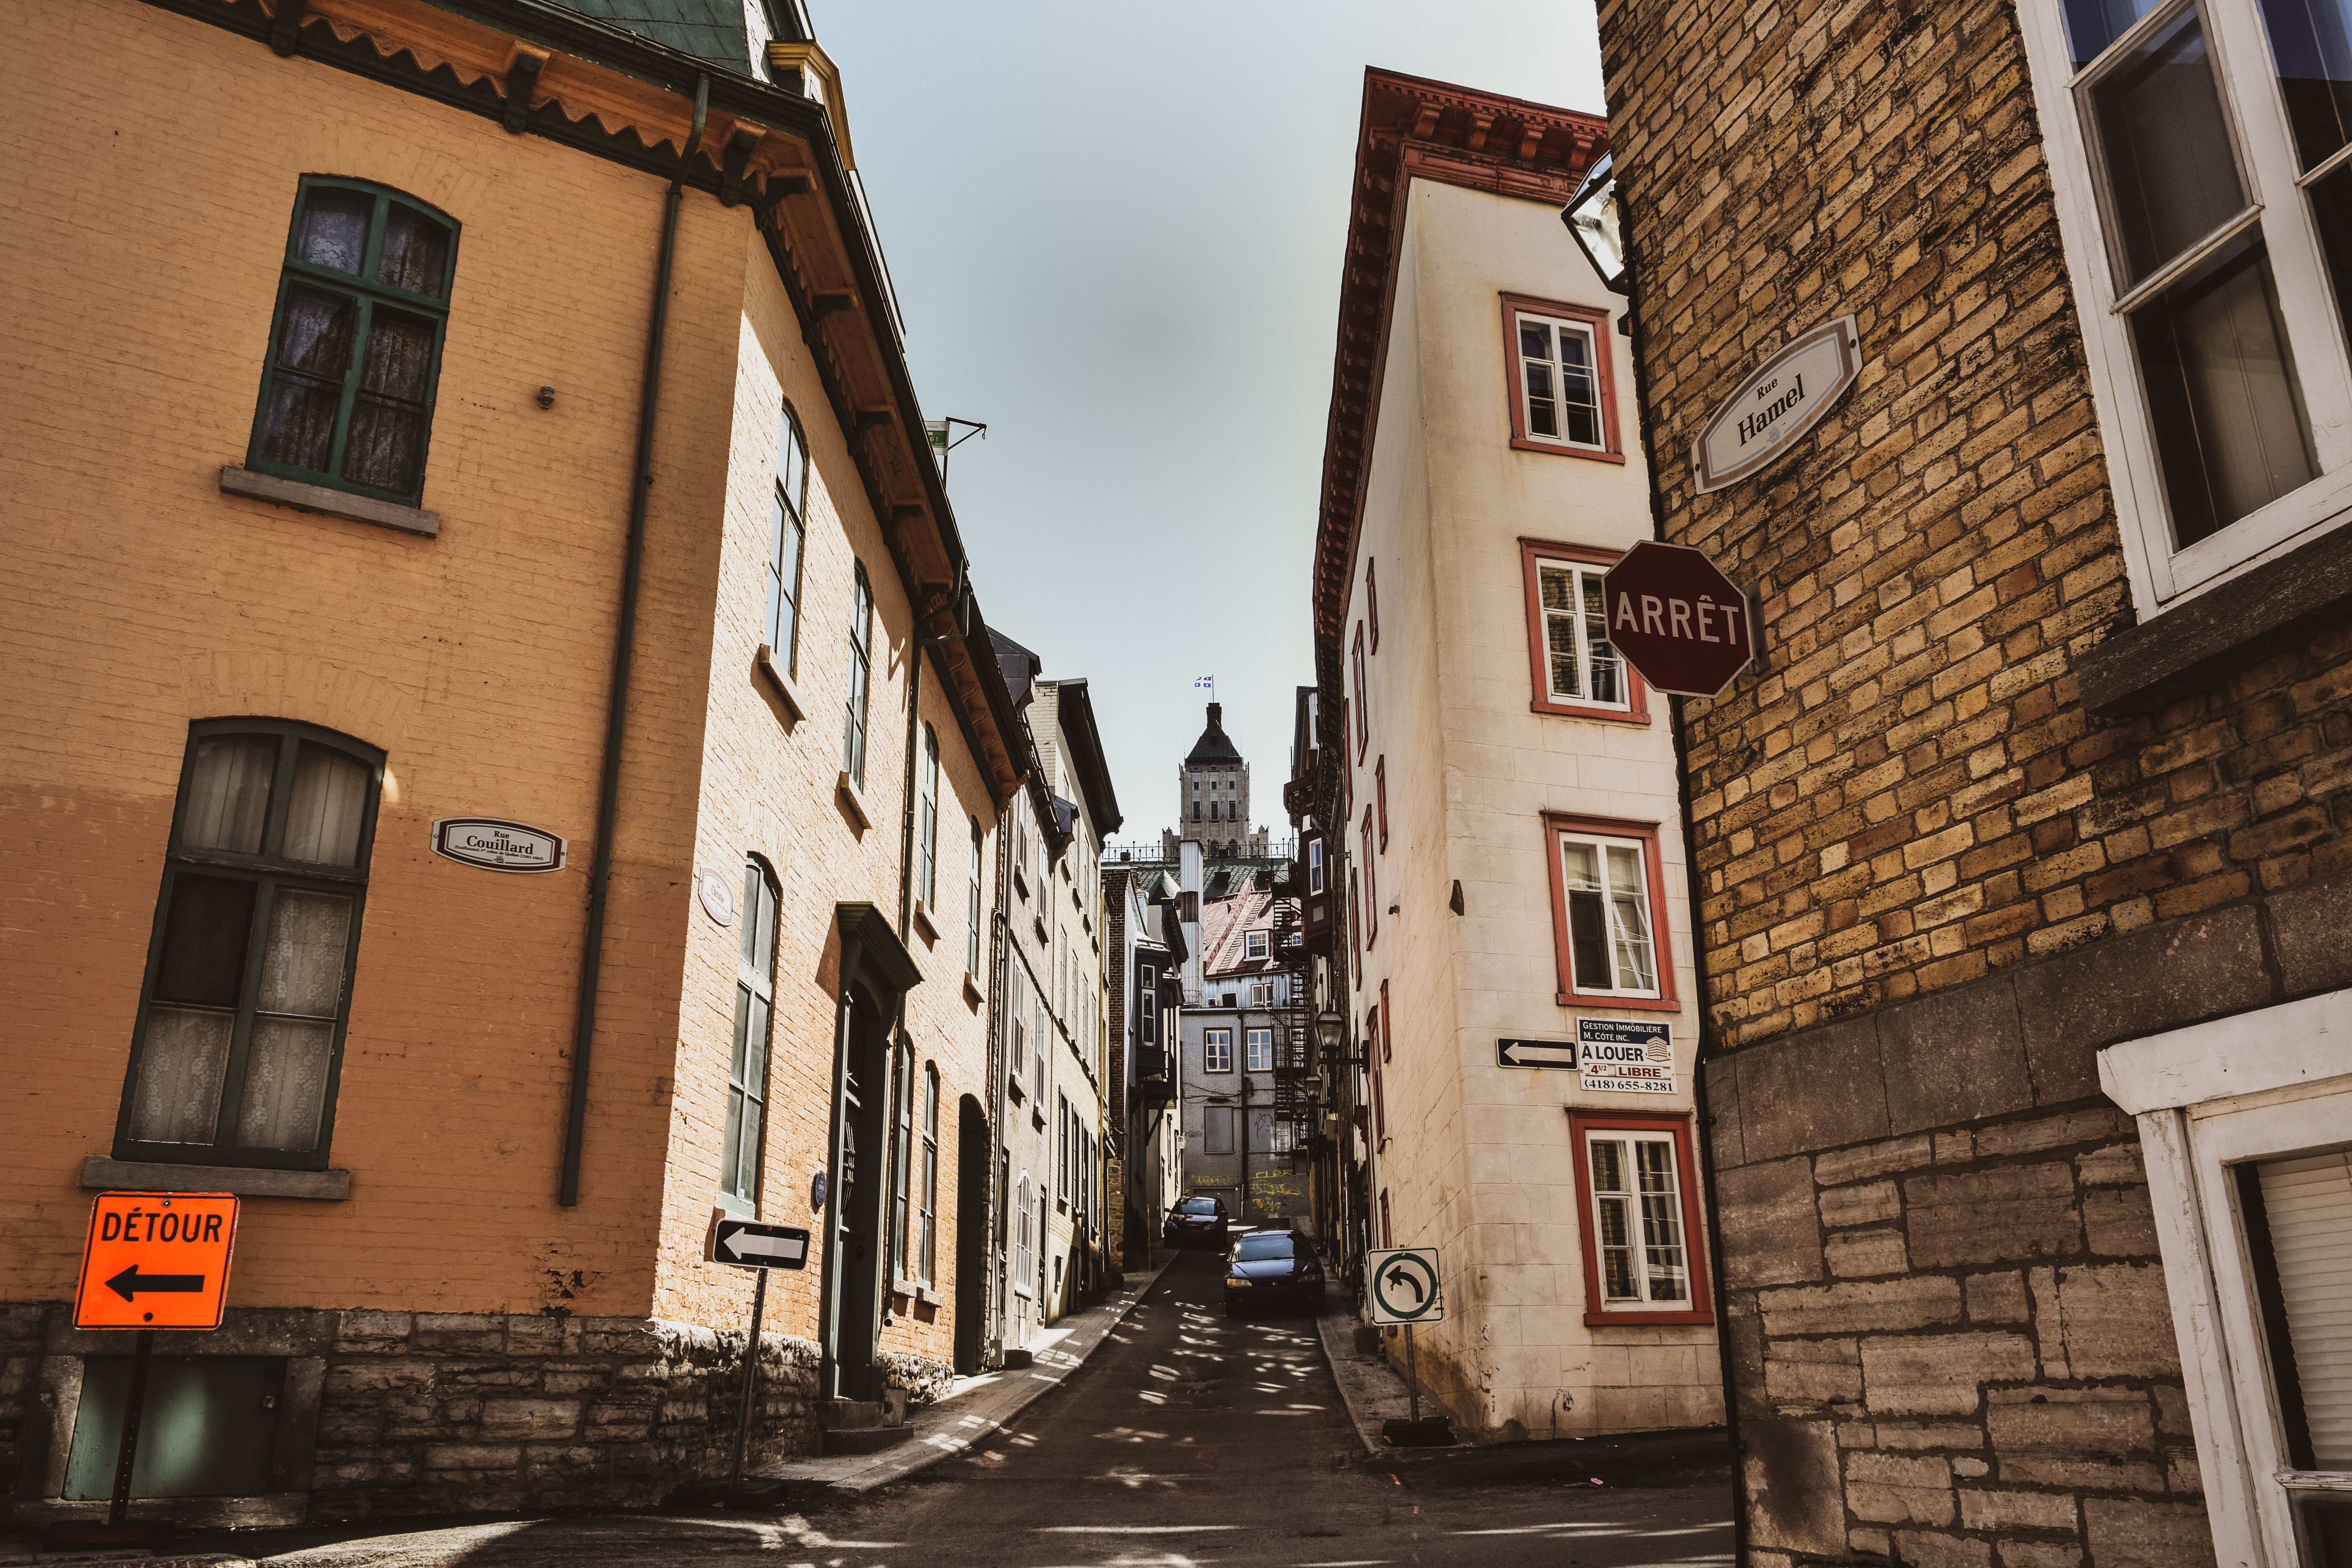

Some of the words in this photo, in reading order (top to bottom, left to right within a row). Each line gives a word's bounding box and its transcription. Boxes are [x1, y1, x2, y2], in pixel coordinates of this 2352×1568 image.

[1757, 378, 1778, 400] Rue
[1737, 373, 1806, 447] Hamel
[1615, 592, 1739, 644] ARRÊT
[467, 835, 533, 855] Couillard
[1582, 1043, 1593, 1059] À
[1595, 1046, 1644, 1062] LOUER
[1619, 1067, 1661, 1077] LIBRE
[1584, 1079, 1614, 1089] (418)
[1618, 1081, 1673, 1091] 655-8281
[101, 1207, 222, 1243] DÉTOUR
